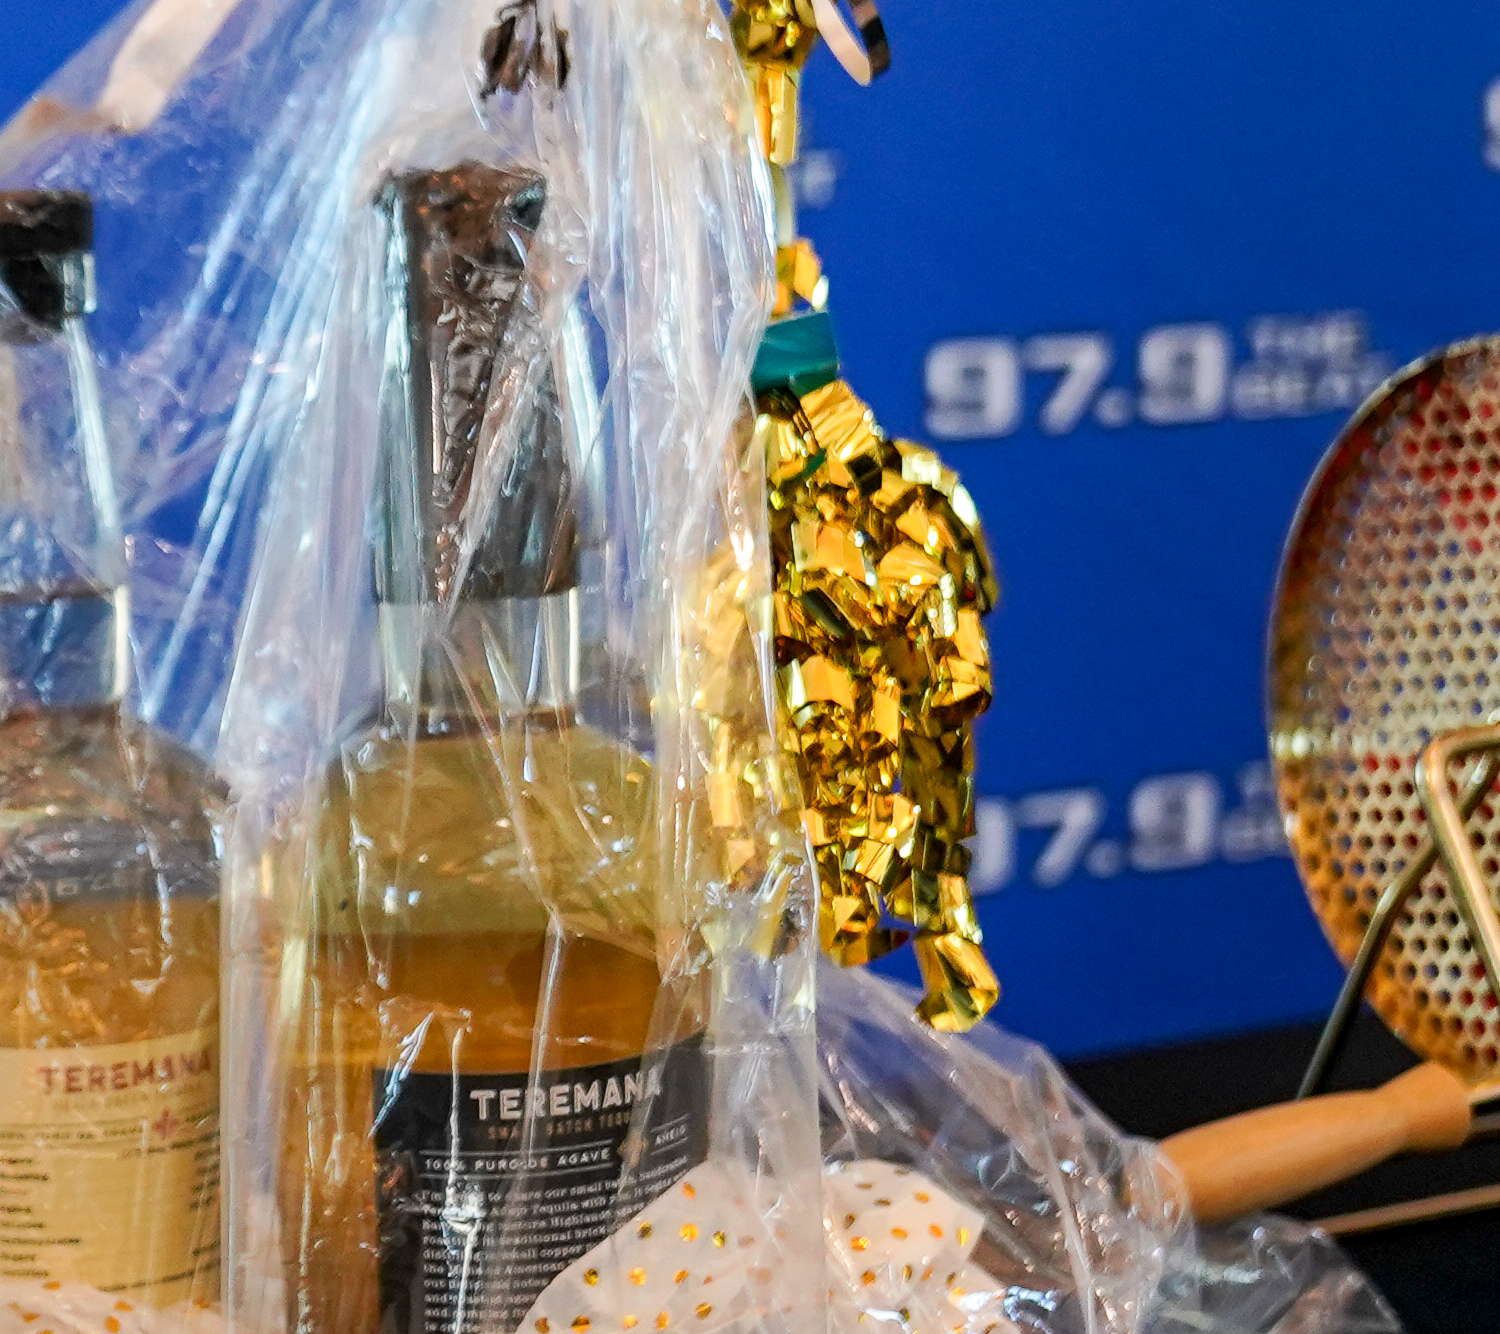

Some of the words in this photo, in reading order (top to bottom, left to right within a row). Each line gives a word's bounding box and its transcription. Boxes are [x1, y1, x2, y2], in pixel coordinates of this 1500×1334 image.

[924, 323, 1232, 439] 97.9
[468, 1069, 662, 1121] TEREMANA
[556, 1147, 611, 1166] AGAVE
